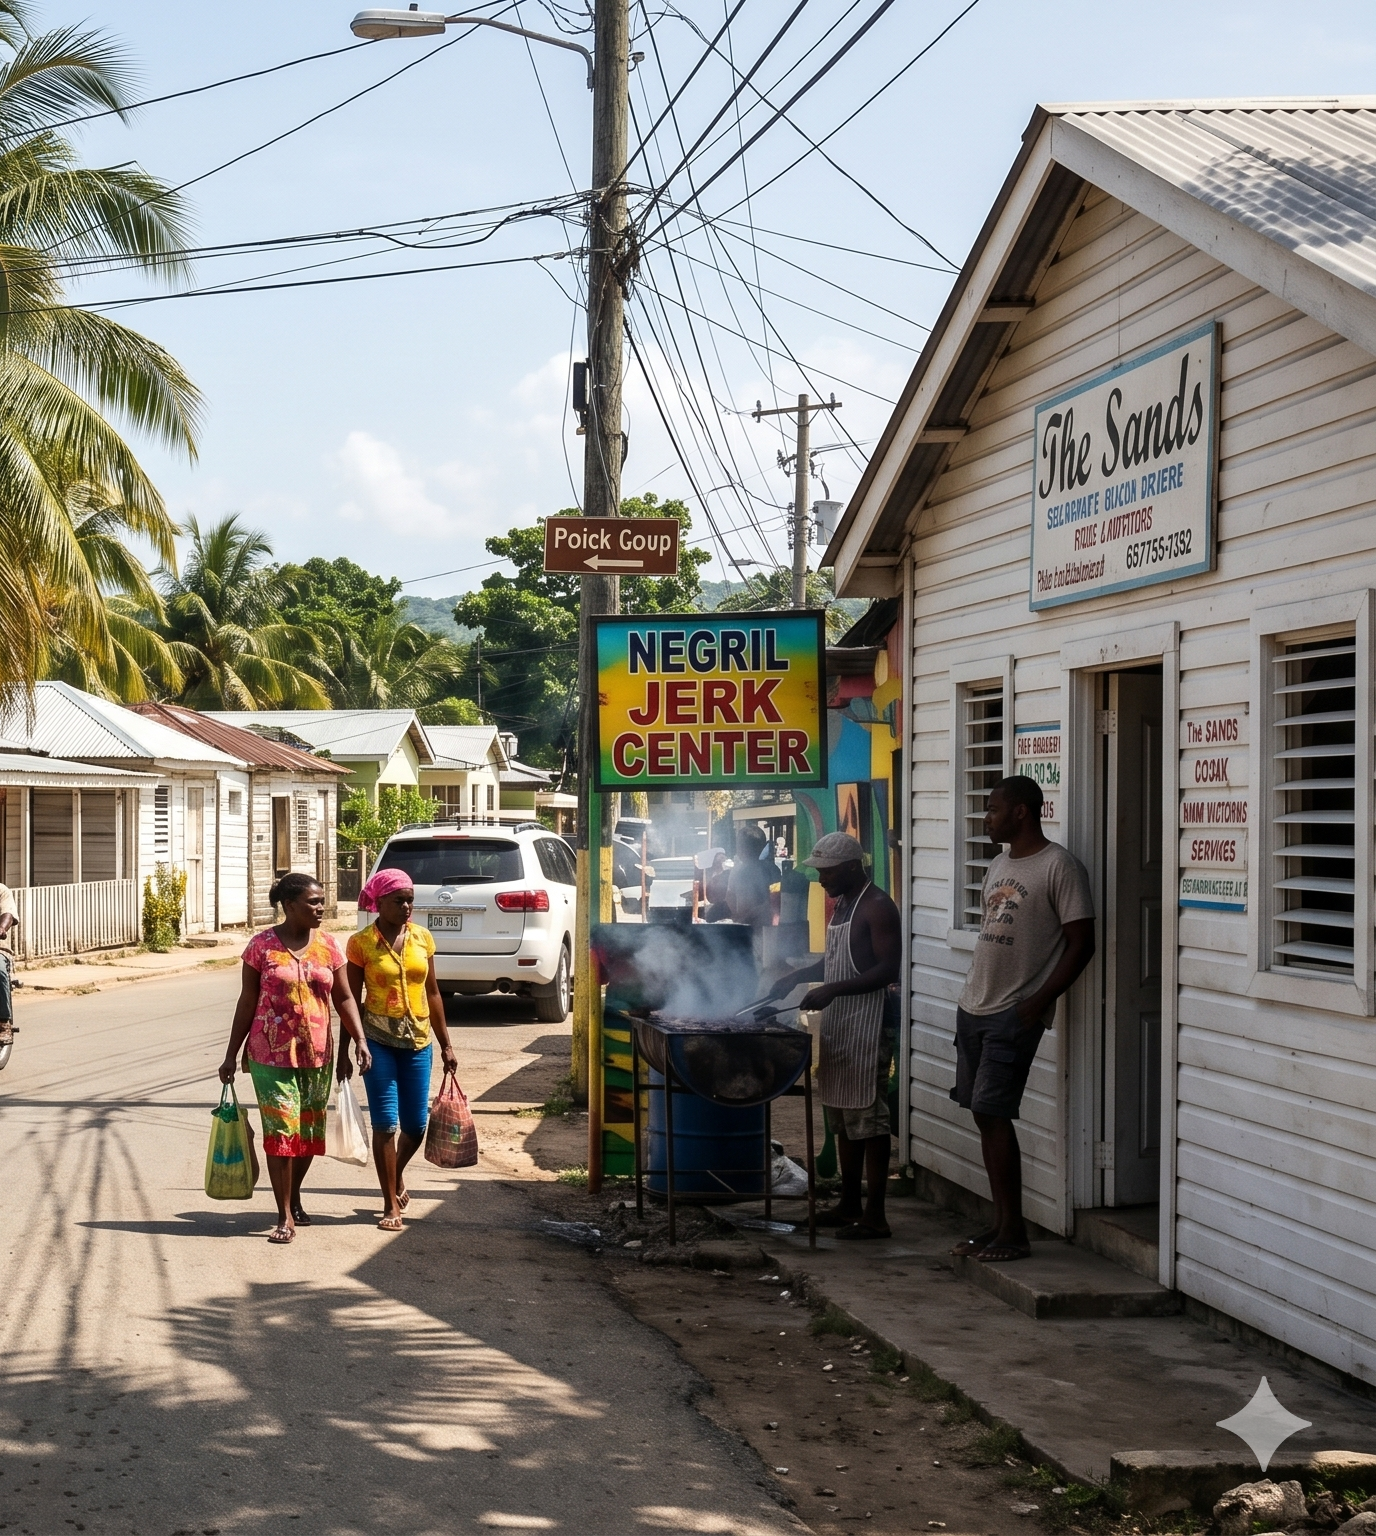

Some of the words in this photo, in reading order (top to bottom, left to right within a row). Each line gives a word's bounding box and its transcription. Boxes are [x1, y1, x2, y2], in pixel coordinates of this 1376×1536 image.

[1038, 407, 1092, 500] The
[1101, 352, 1203, 477] Sands
[555, 527, 611, 550] Poick
[619, 528, 672, 556] Goup
[628, 628, 790, 675] NEGRIL
[627, 678, 785, 726] JERK
[612, 729, 814, 778] CENTER
[1205, 718, 1238, 743] SANDS
